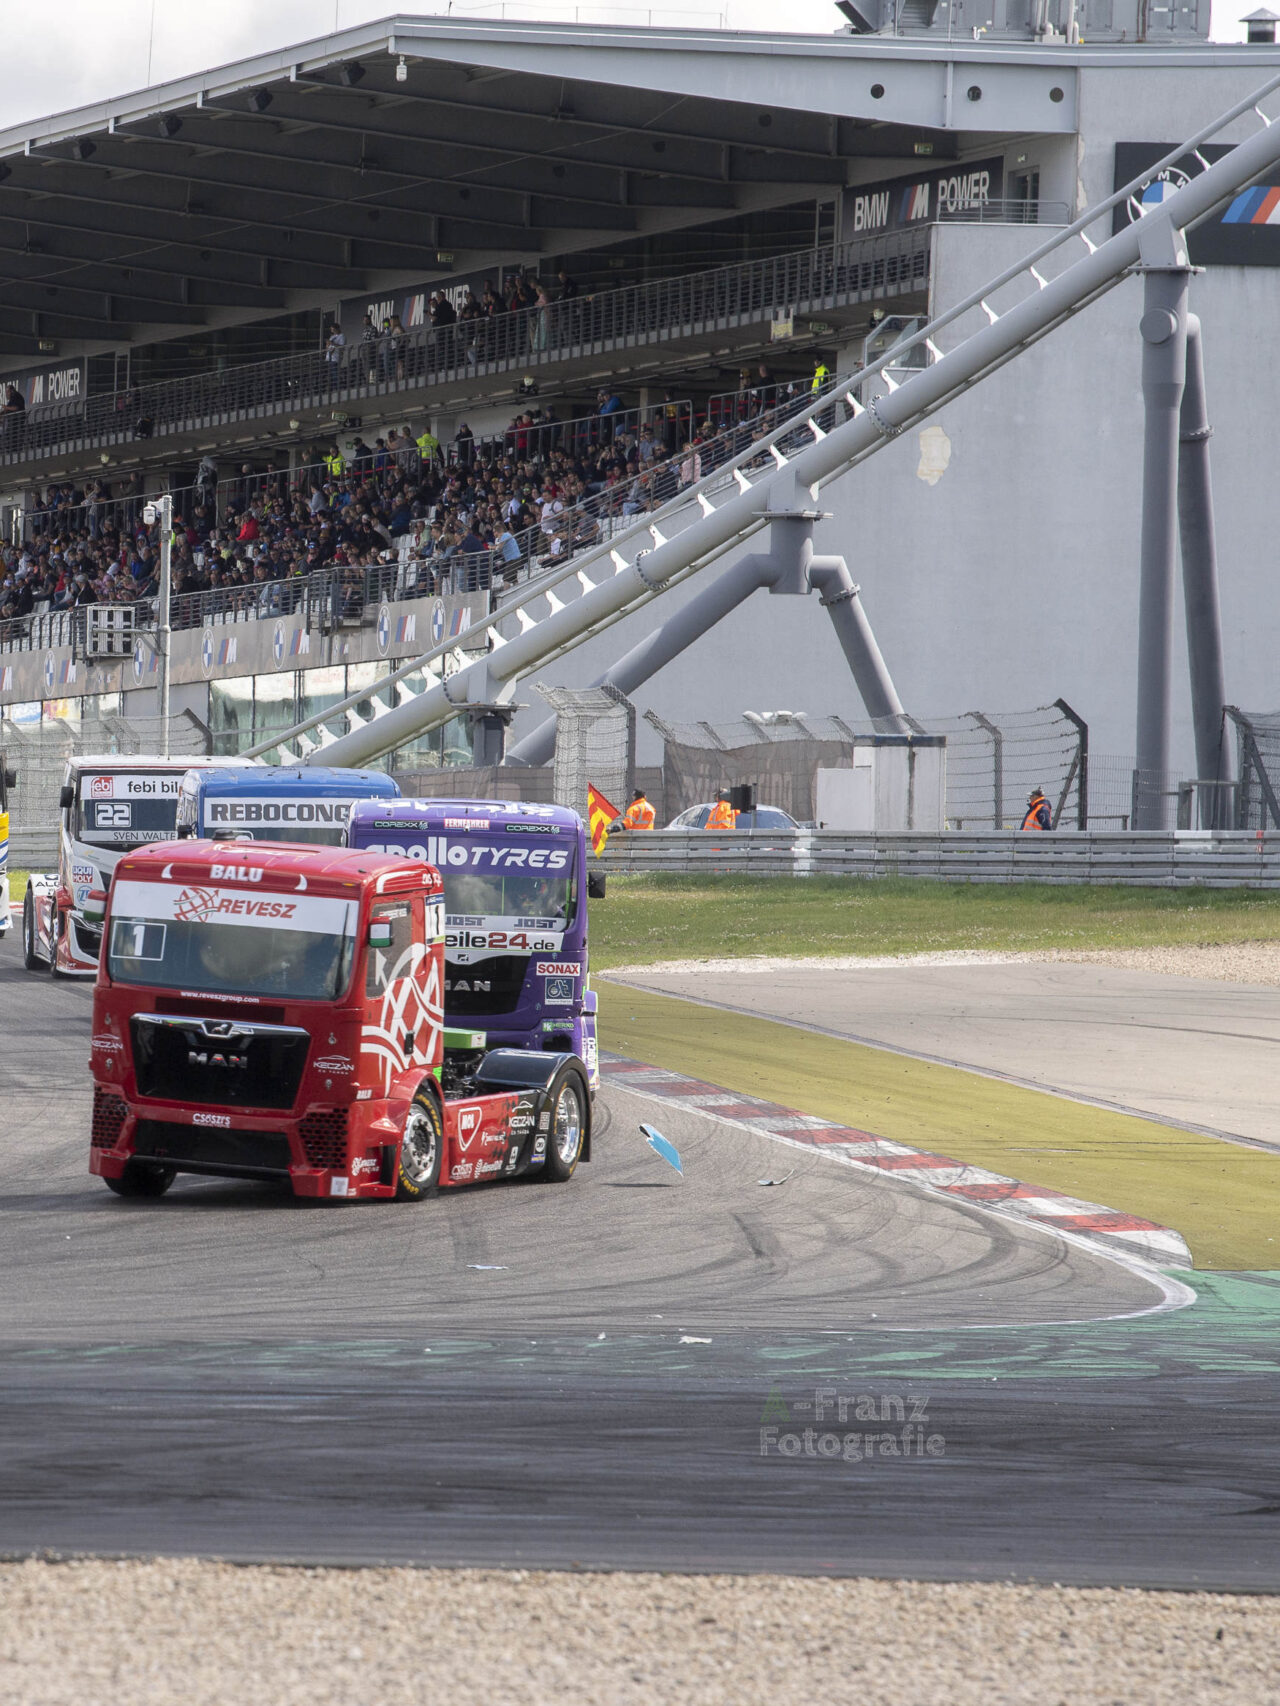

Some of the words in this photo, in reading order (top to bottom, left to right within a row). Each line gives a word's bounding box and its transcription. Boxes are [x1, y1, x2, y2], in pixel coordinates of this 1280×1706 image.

[854, 191, 890, 232] BMW
[938, 171, 990, 214] POWER
[48, 368, 80, 400] POWER
[128, 781, 156, 793] febi
[161, 781, 178, 793] bil
[97, 804, 129, 826] 22
[113, 832, 139, 840] SVEN
[142, 832, 176, 840] WALTE
[471, 847, 569, 869] TYRES
[209, 864, 264, 882] BALU
[445, 916, 486, 926] JOST
[513, 919, 557, 929] JOST
[132, 925, 145, 957] 1
[538, 964, 579, 974] SONAX
[180, 991, 260, 1004] www.reveszgroup.com
[188, 1051, 247, 1068] MAN
